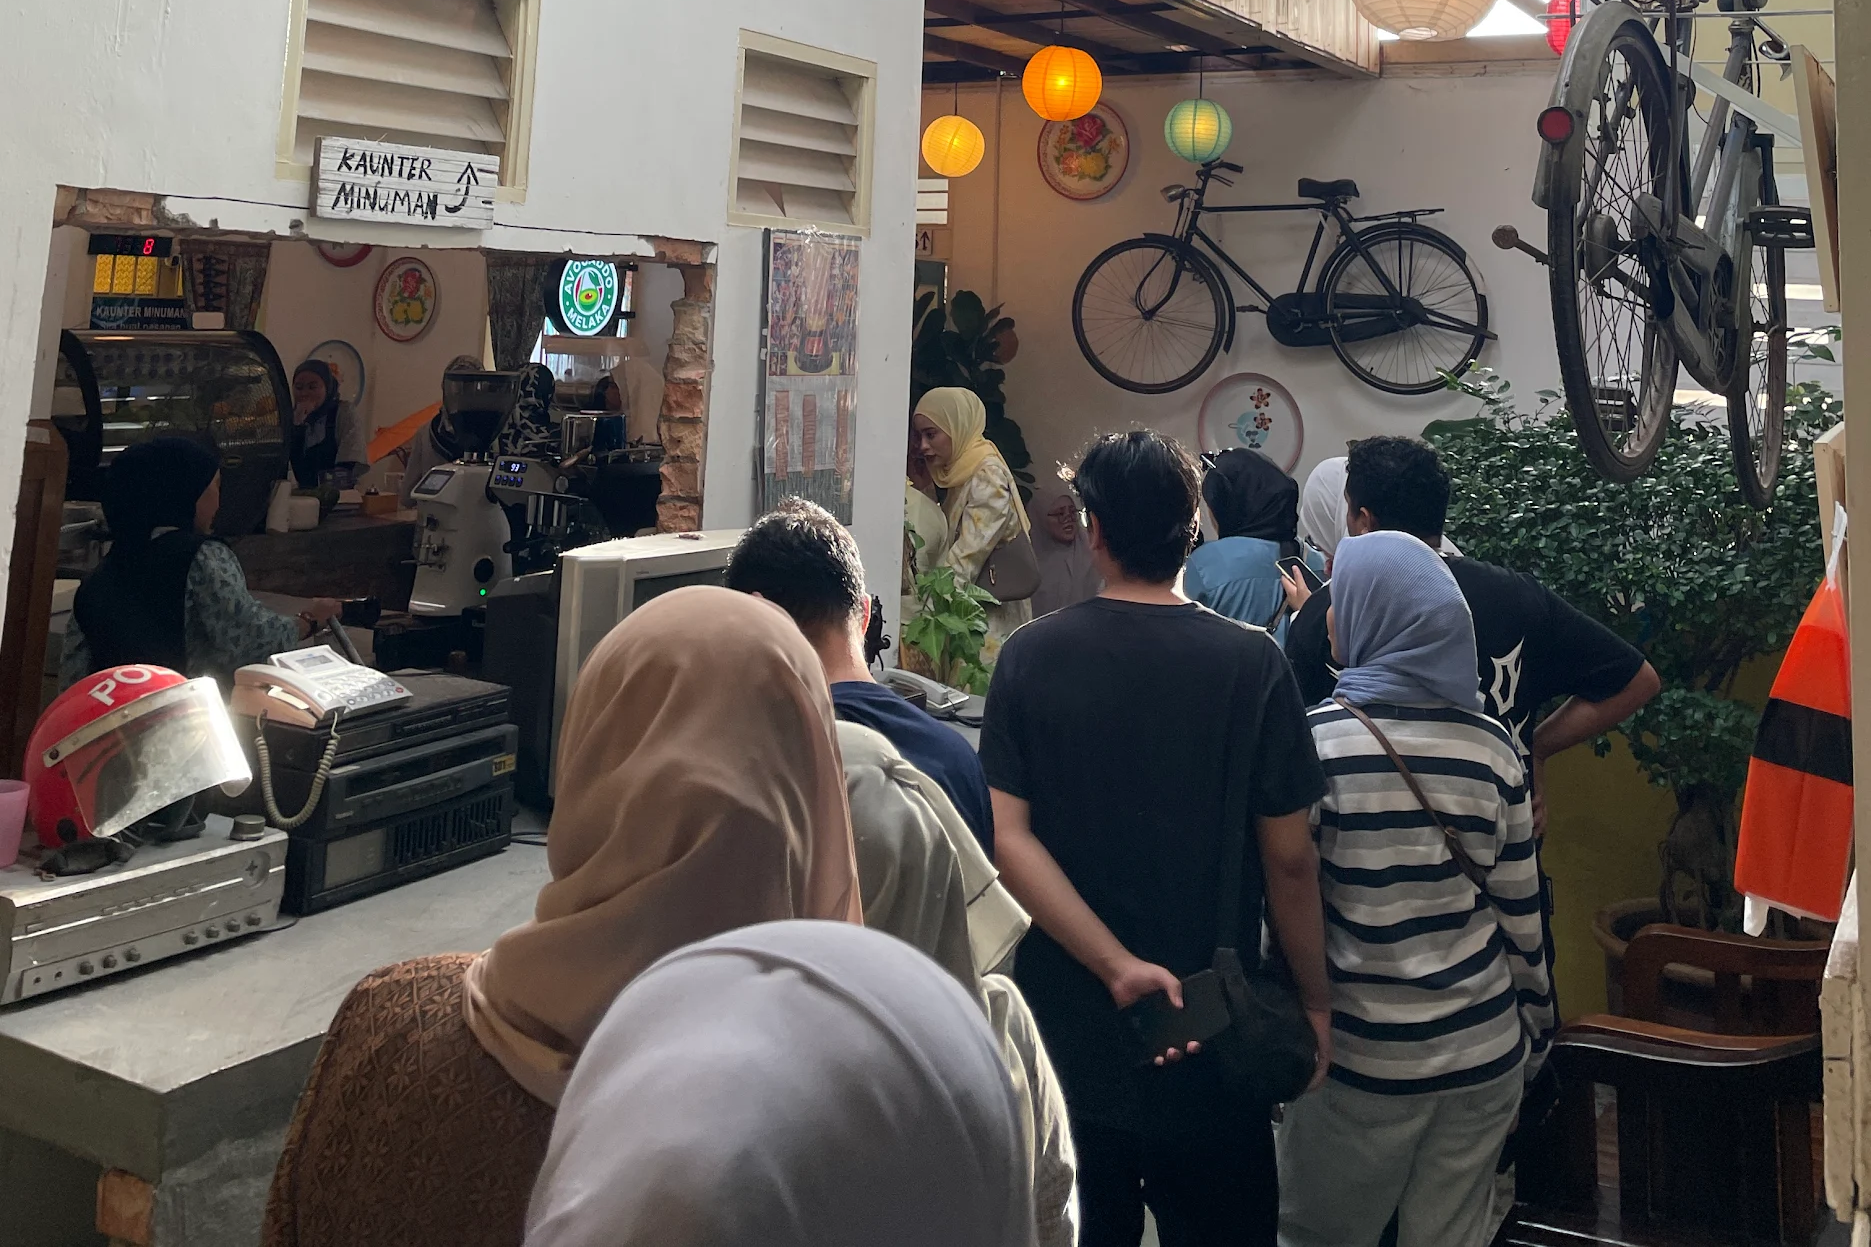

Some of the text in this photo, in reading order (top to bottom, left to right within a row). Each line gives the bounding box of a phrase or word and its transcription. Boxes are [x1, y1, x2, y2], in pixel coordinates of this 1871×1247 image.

[337, 147, 432, 181] KAUNTER
[331, 181, 439, 221] MINUMAN
[96, 306, 142, 318] KAUNTER
[567, 304, 610, 329] MELAKA
